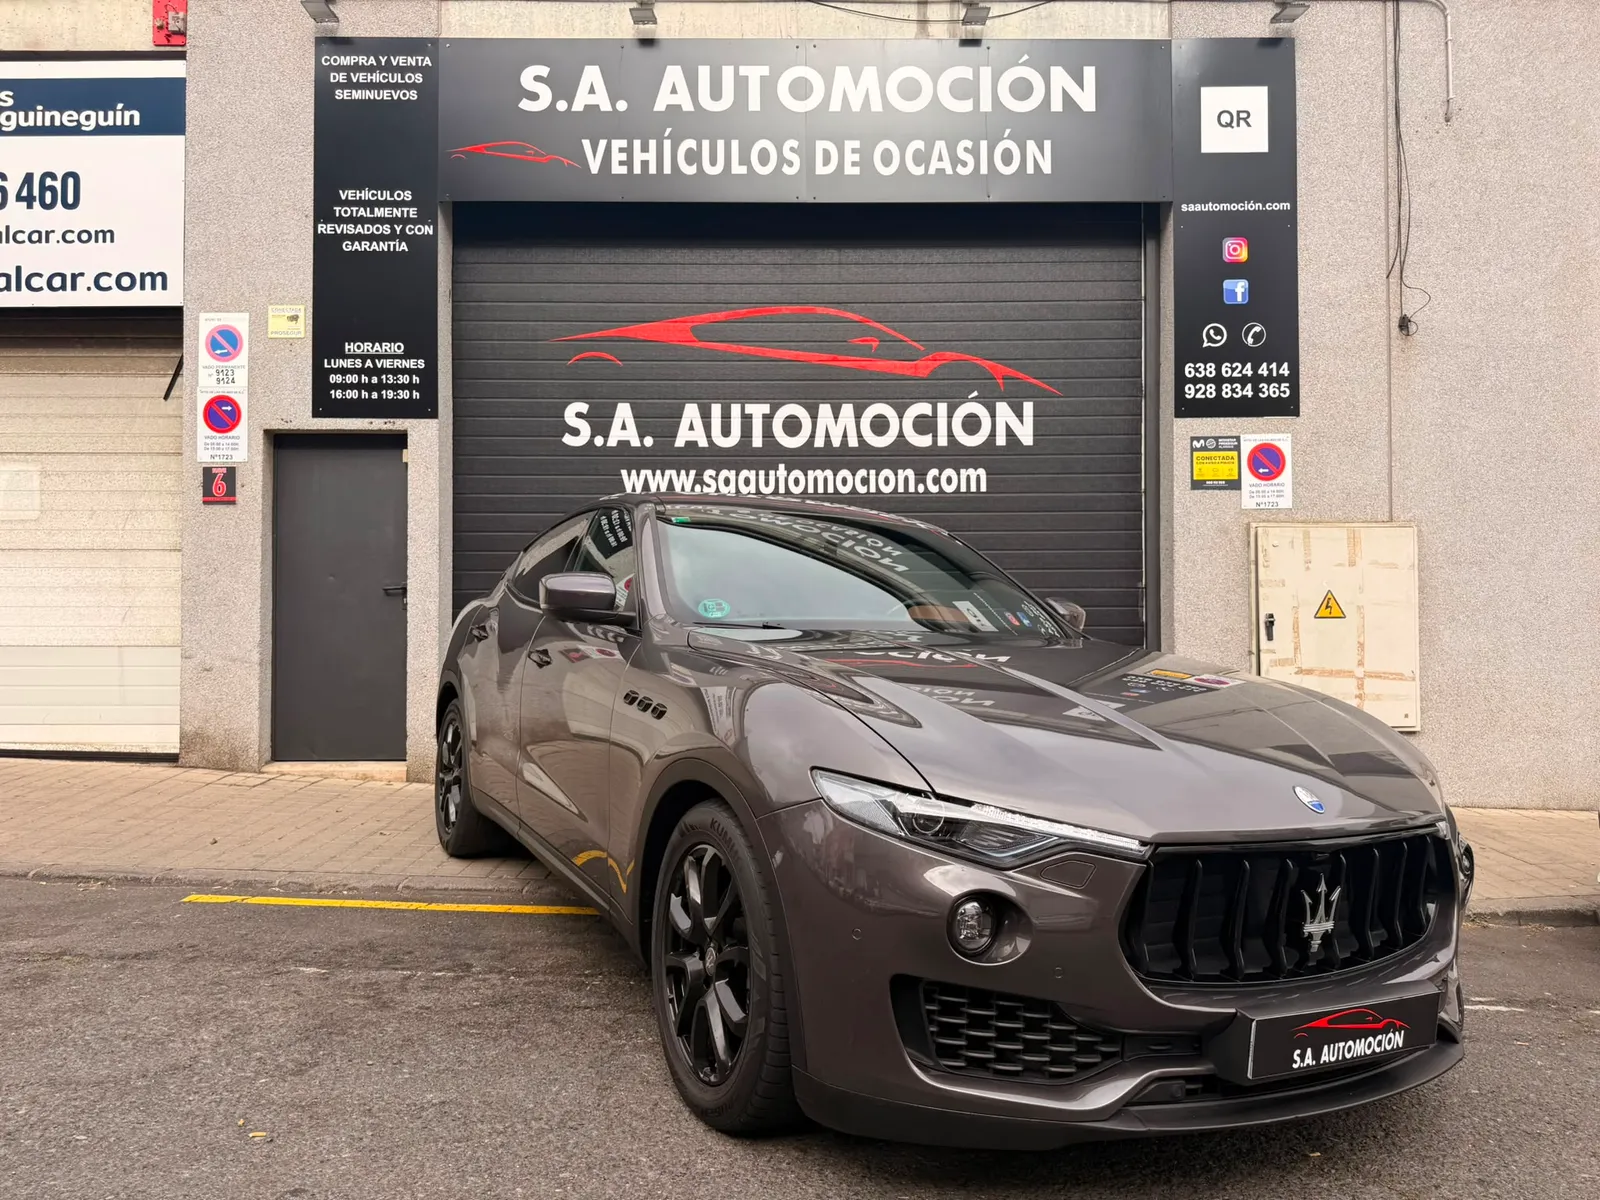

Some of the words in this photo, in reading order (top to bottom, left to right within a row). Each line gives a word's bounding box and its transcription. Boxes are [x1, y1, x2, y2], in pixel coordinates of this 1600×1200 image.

[321, 55, 377, 66] COMPRA
[379, 55, 388, 66] Y
[390, 56, 432, 66] VENTA
[330, 72, 348, 83] DE
[350, 70, 423, 83] VEHÍCULOS
[518, 65, 628, 112] S.A.
[653, 54, 1096, 112] AUTOMOCIÓN
[335, 89, 418, 100] SEMINUEVOS
[1217, 110, 1252, 129] QR
[581, 128, 801, 175] VEHÍCULOS
[815, 140, 861, 175] DE
[873, 128, 1052, 176] OCASIÓN
[15, 171, 81, 210] 460
[339, 187, 412, 201] VEHÍCULOS
[333, 207, 418, 218] TOTALMENTE
[1181, 201, 1291, 211] saautomoción.com
[317, 224, 391, 235] REVISADOS
[394, 225, 403, 235] Y
[406, 225, 433, 235] CON
[342, 239, 409, 252] GARANTÍA
[345, 342, 404, 354] HORARIO
[324, 359, 362, 368] LUNES
[364, 359, 374, 368] A
[375, 359, 425, 368] VIERNES
[1184, 363, 1216, 378] 638
[1221, 363, 1253, 378] 624
[1258, 362, 1290, 377] 414
[216, 377, 236, 385] 9124
[329, 374, 359, 384] 09:00
[361, 374, 368, 384] h
[371, 376, 378, 384] a
[381, 374, 410, 384] 13:30
[412, 375, 420, 384] h
[329, 390, 359, 399] 16:00
[361, 390, 368, 399] h
[371, 391, 378, 399] a
[381, 390, 410, 399] 19:30
[412, 390, 420, 399] h
[1184, 384, 1216, 399] 928
[1221, 383, 1254, 398] 834
[1259, 383, 1291, 398] 365
[561, 402, 654, 447] S.A.
[674, 390, 1034, 448] AUTOMOCIÓN
[212, 474, 226, 496] 6
[620, 463, 987, 495] www.saautomocion.com
[1292, 1047, 1316, 1068] S.A.
[1320, 1028, 1405, 1064] AUTOMOCIÓN
